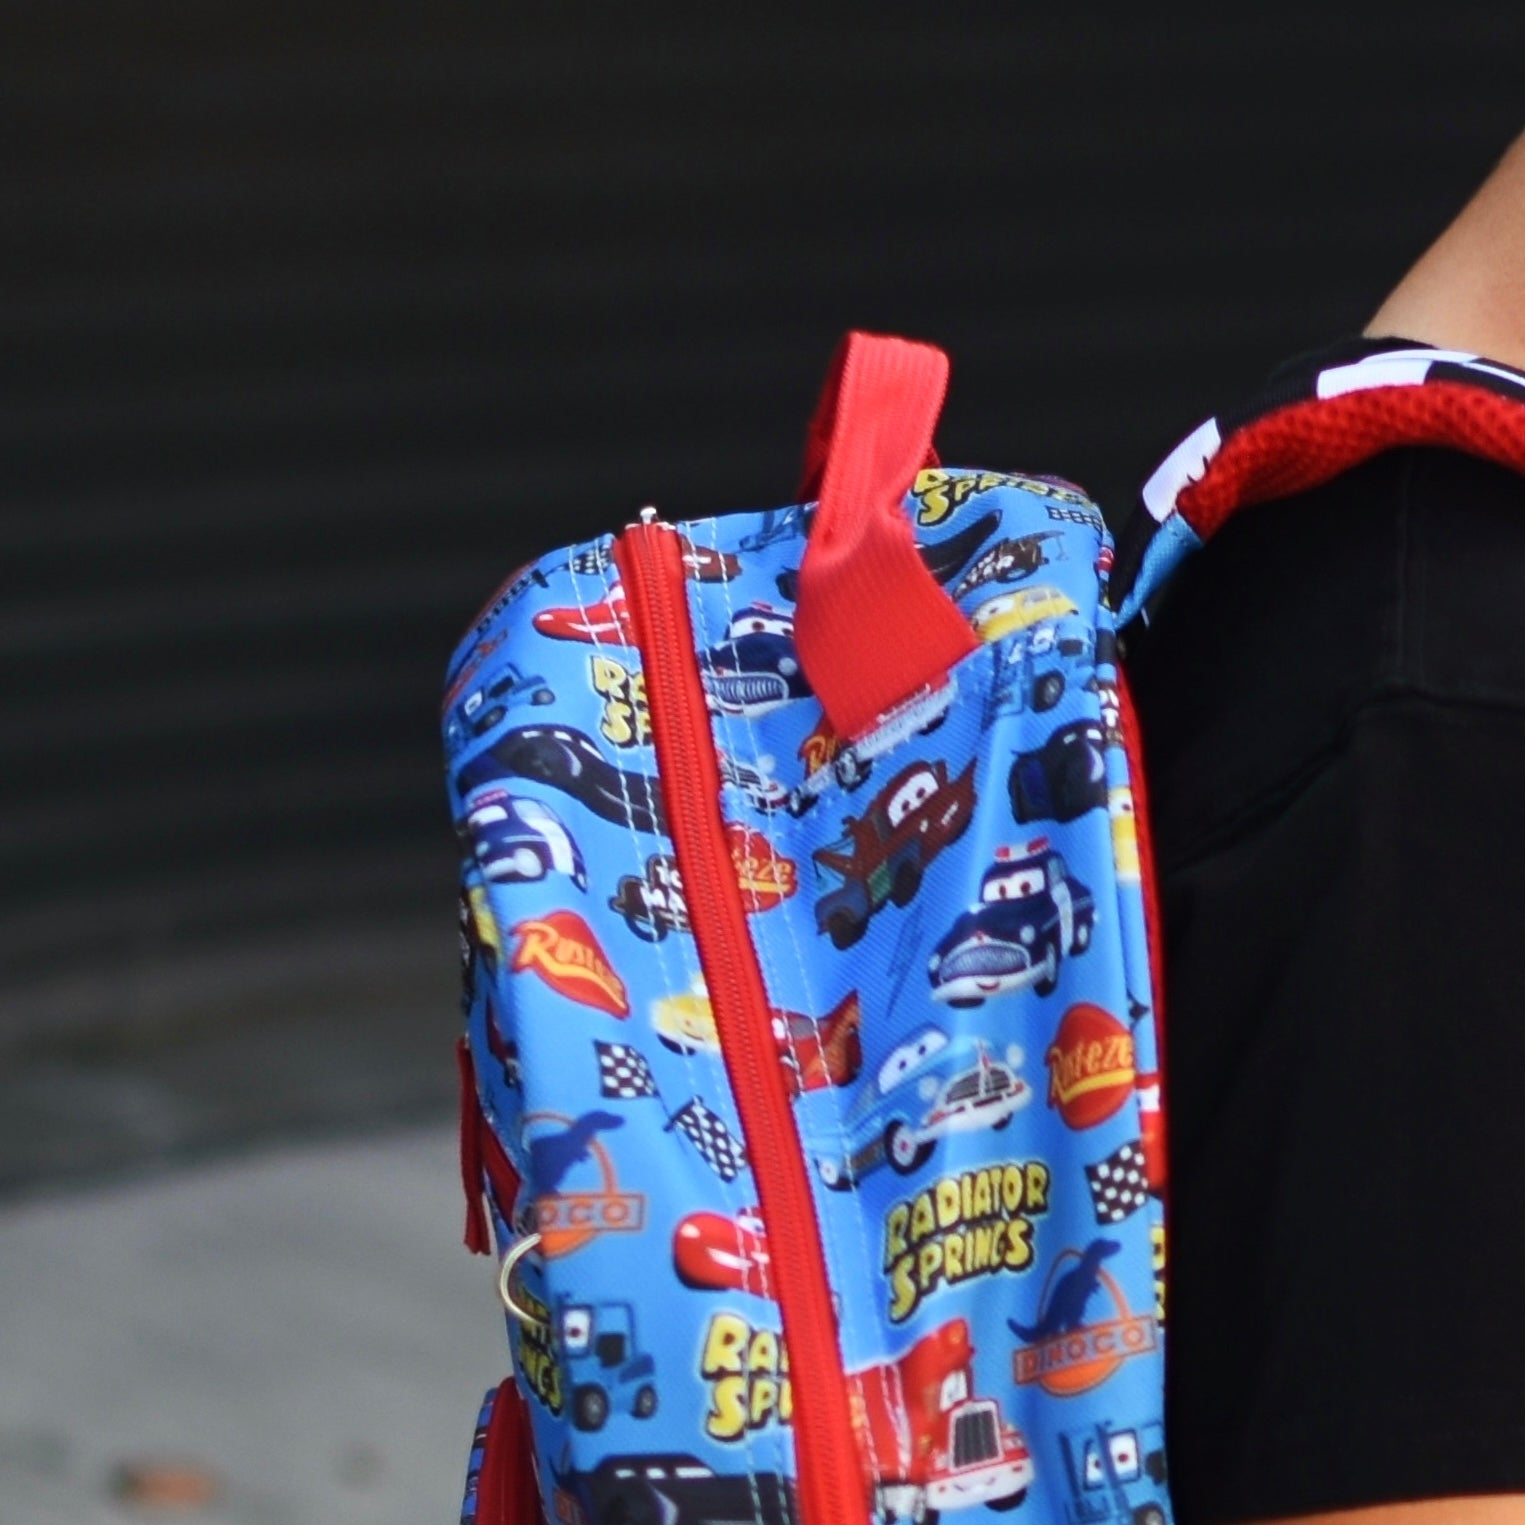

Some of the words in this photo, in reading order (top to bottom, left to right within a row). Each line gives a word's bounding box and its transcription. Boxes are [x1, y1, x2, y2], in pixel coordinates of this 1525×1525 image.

[884, 1161, 1049, 1274] RADIATOR
[888, 1216, 1034, 1323] SPRINGS
[701, 1312, 790, 1380] RA
